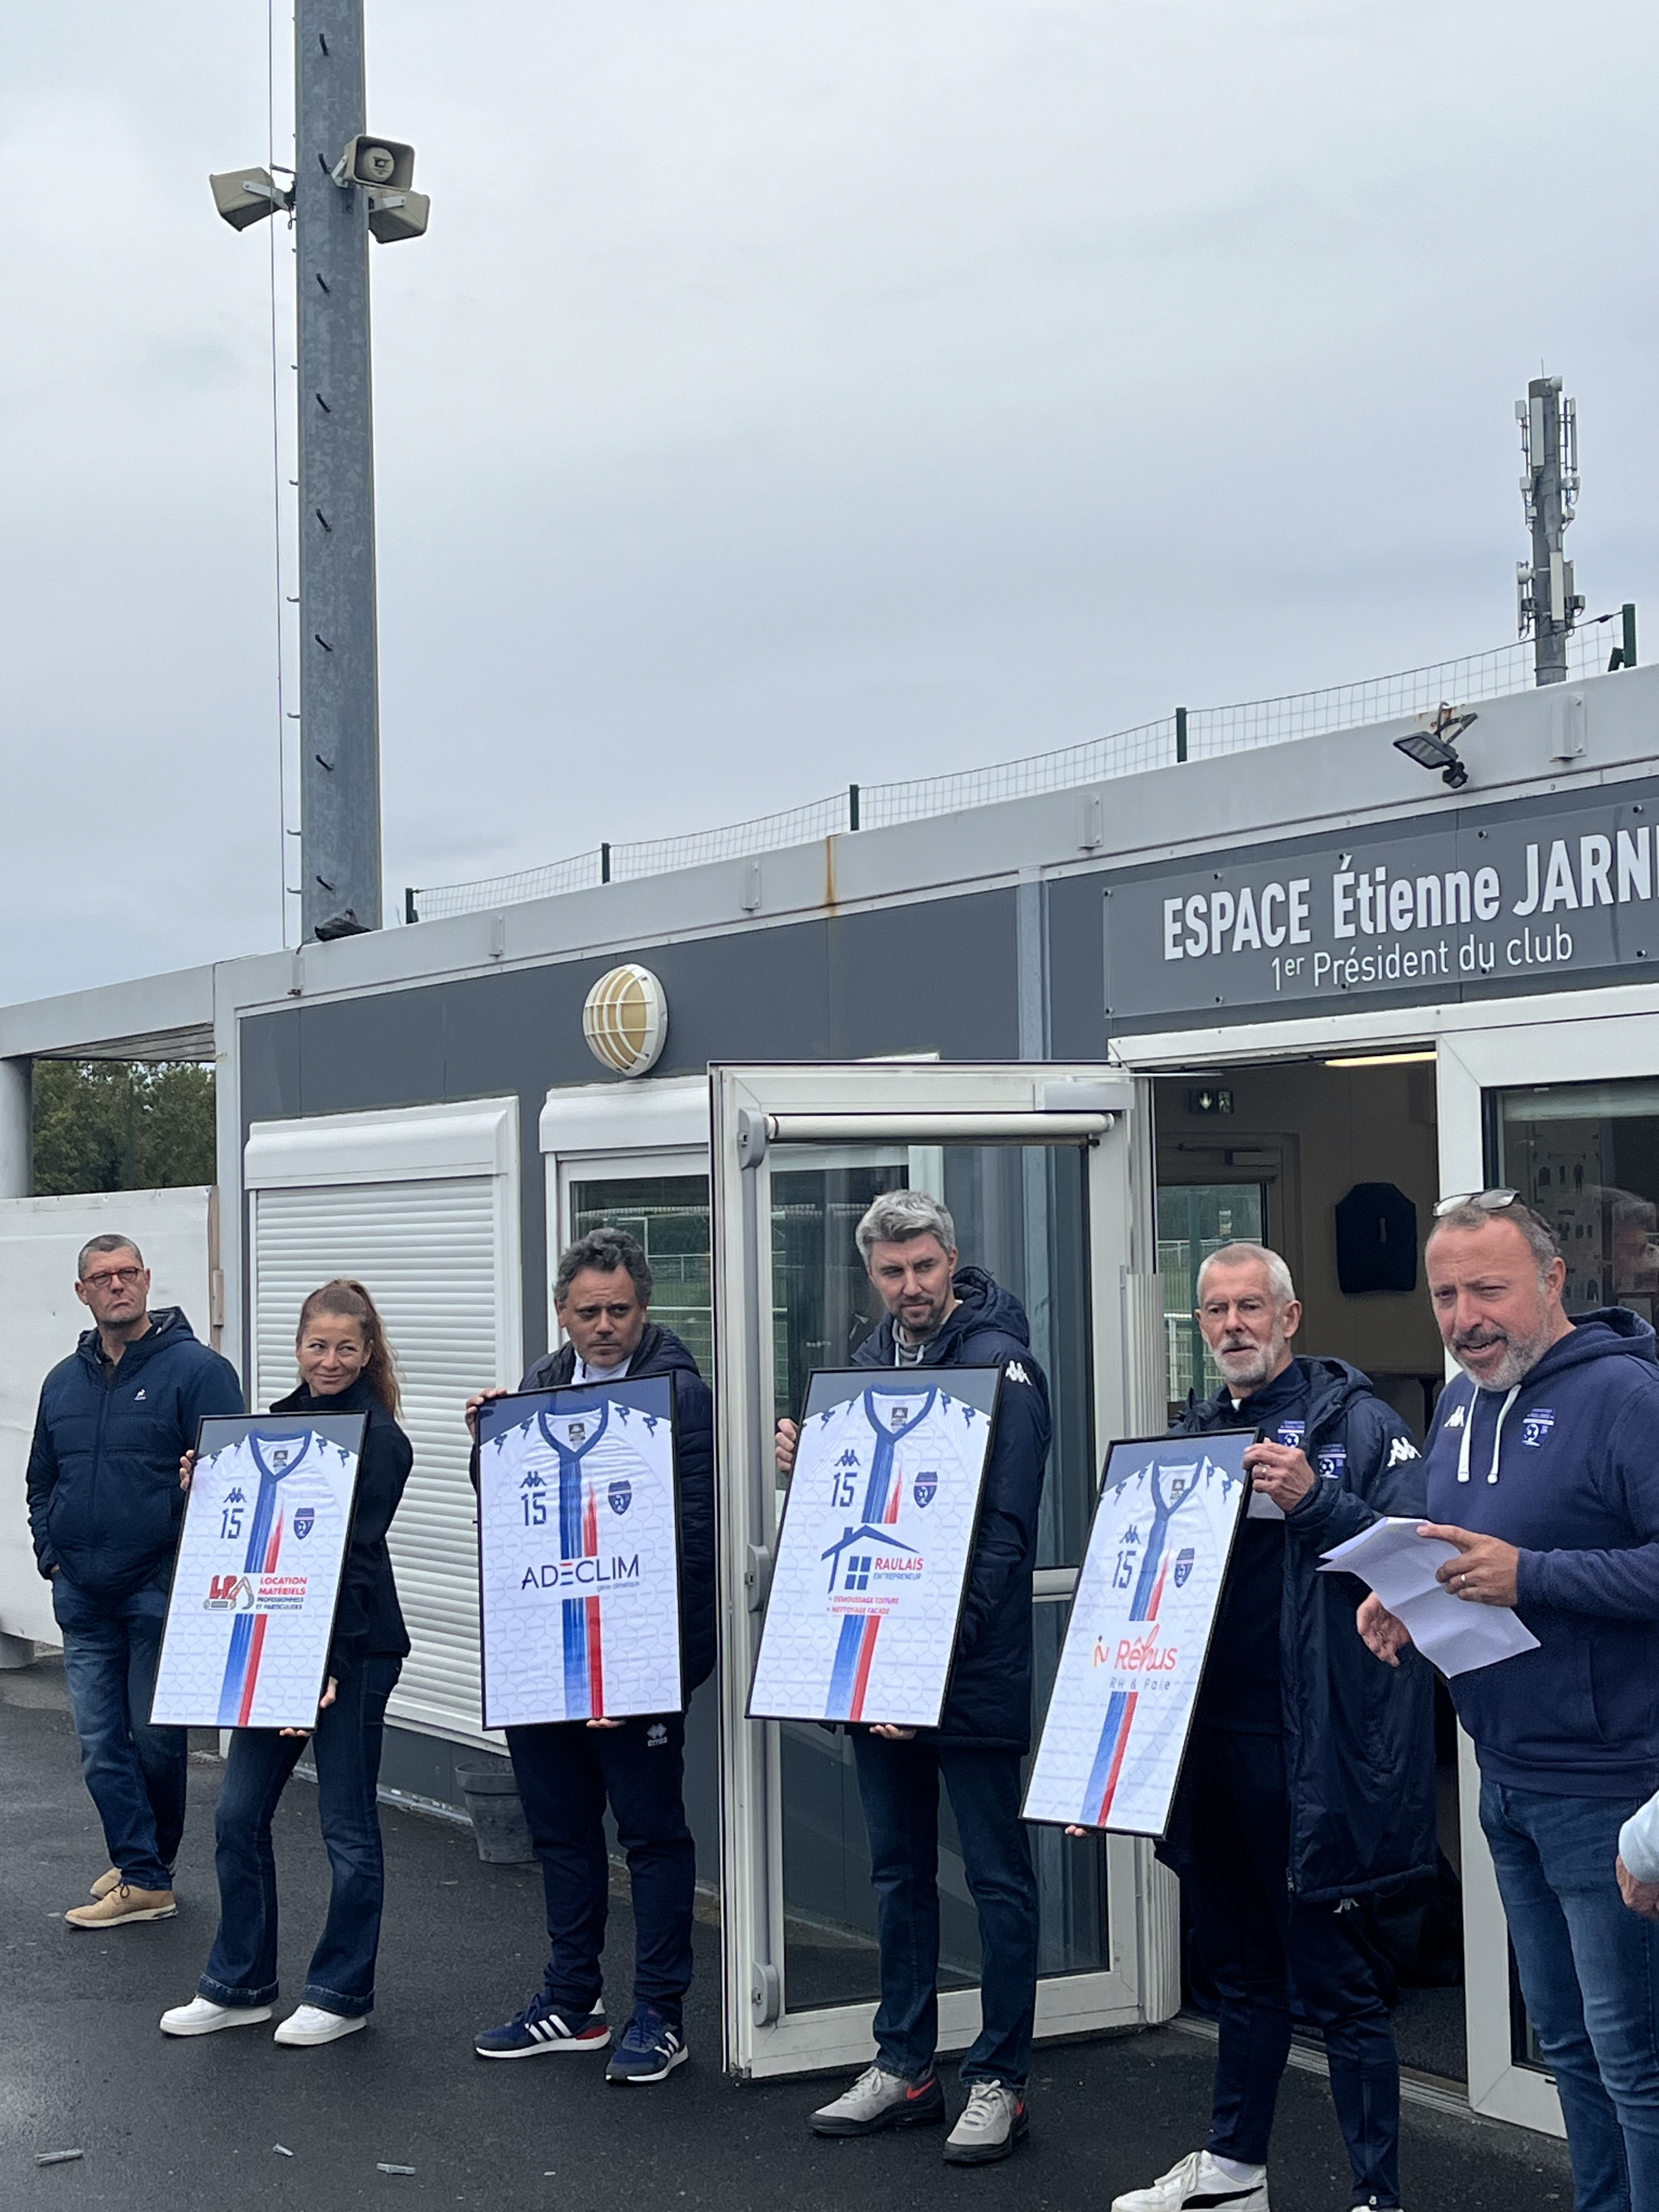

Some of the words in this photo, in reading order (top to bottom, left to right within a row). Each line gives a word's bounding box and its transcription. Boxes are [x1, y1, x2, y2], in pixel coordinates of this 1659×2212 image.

[1164, 878, 1311, 961] ESPACE
[1333, 854, 1500, 939] Étienne
[1512, 824, 1659, 917] JARN
[1271, 957, 1305, 991] 1er
[1313, 940, 1449, 987] Président
[1459, 933, 1495, 971] du
[1506, 923, 1573, 966] club
[831, 1472, 857, 1508] 15
[220, 1508, 244, 1539] 15
[521, 1492, 546, 1526] 15
[521, 1554, 640, 1590] ADECLIM
[874, 1557, 924, 1570] RAULAIS
[1112, 1550, 1137, 1589] 15
[1109, 1677, 1124, 1690] RH
